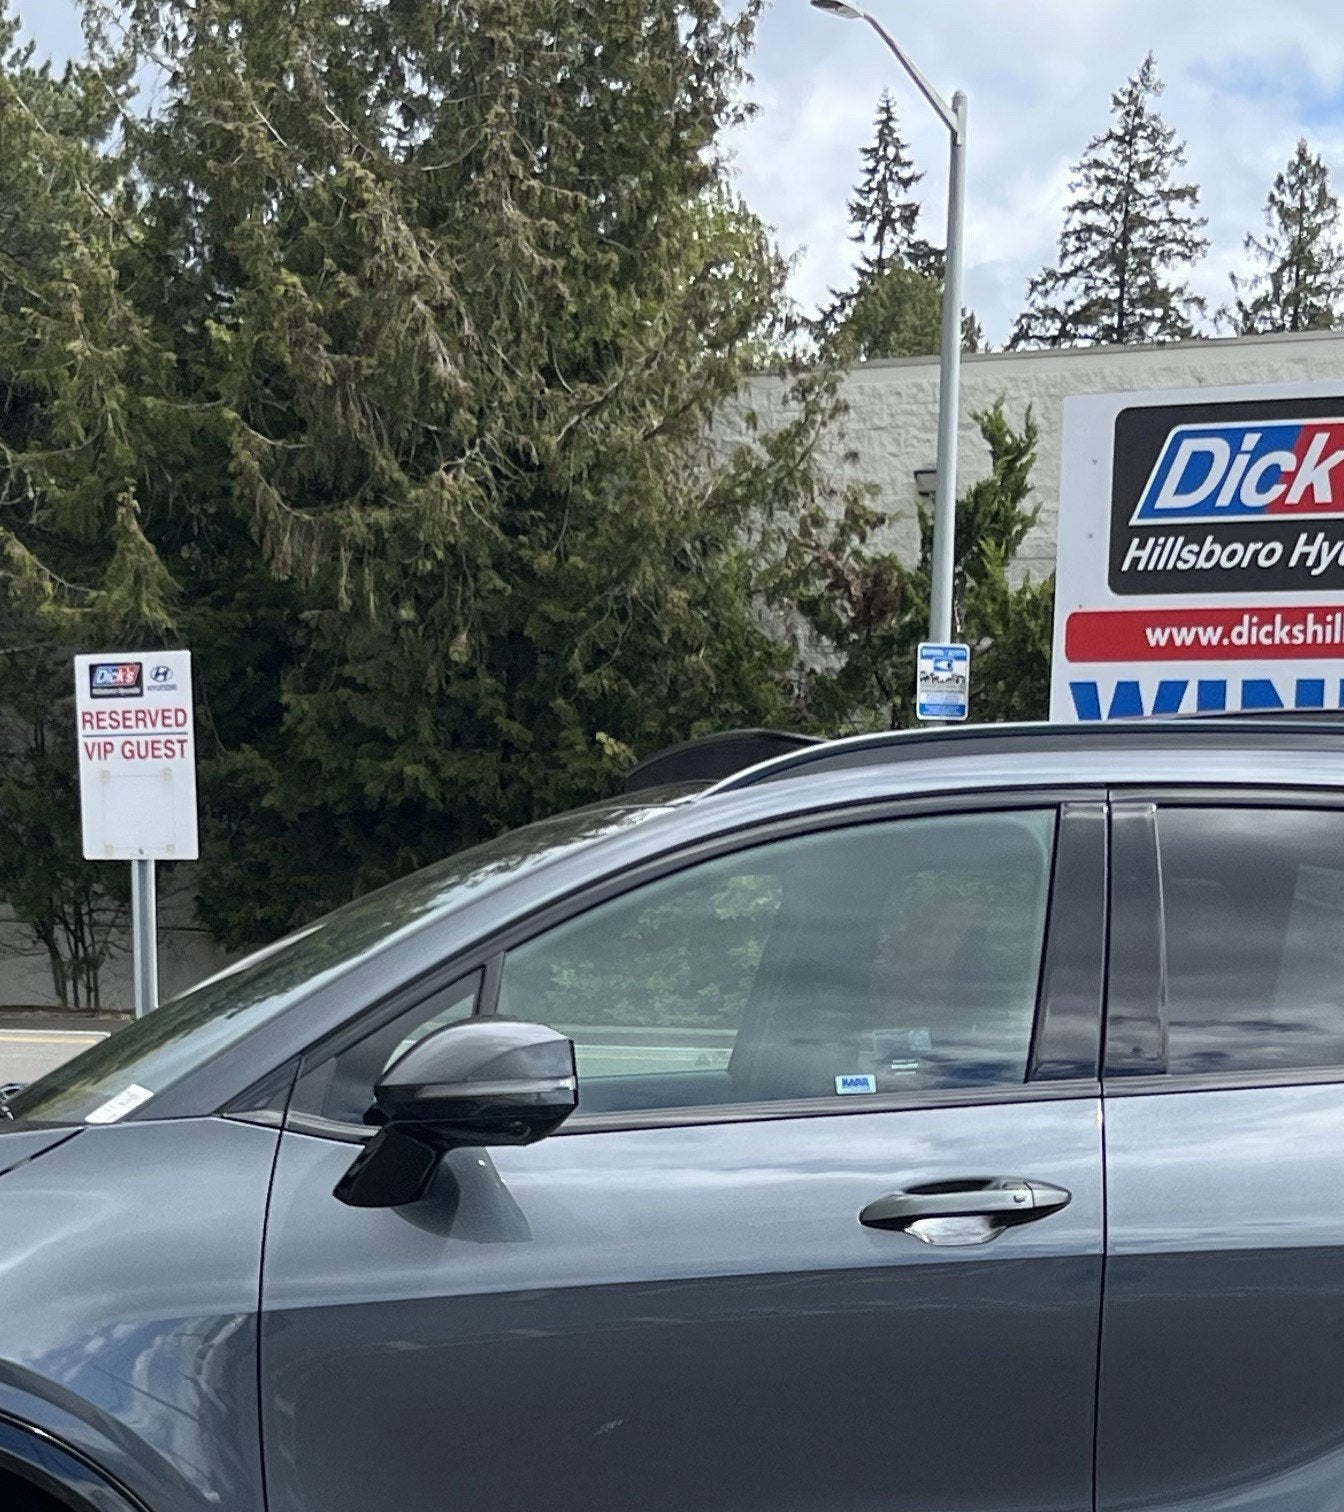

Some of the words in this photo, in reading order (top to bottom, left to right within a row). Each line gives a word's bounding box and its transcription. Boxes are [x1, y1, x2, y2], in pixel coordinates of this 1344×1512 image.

[1121, 533, 1283, 572] Hillsboro
[81, 708, 188, 730] RESERVED
[84, 741, 115, 761] VIP
[121, 738, 188, 760] GUEST
